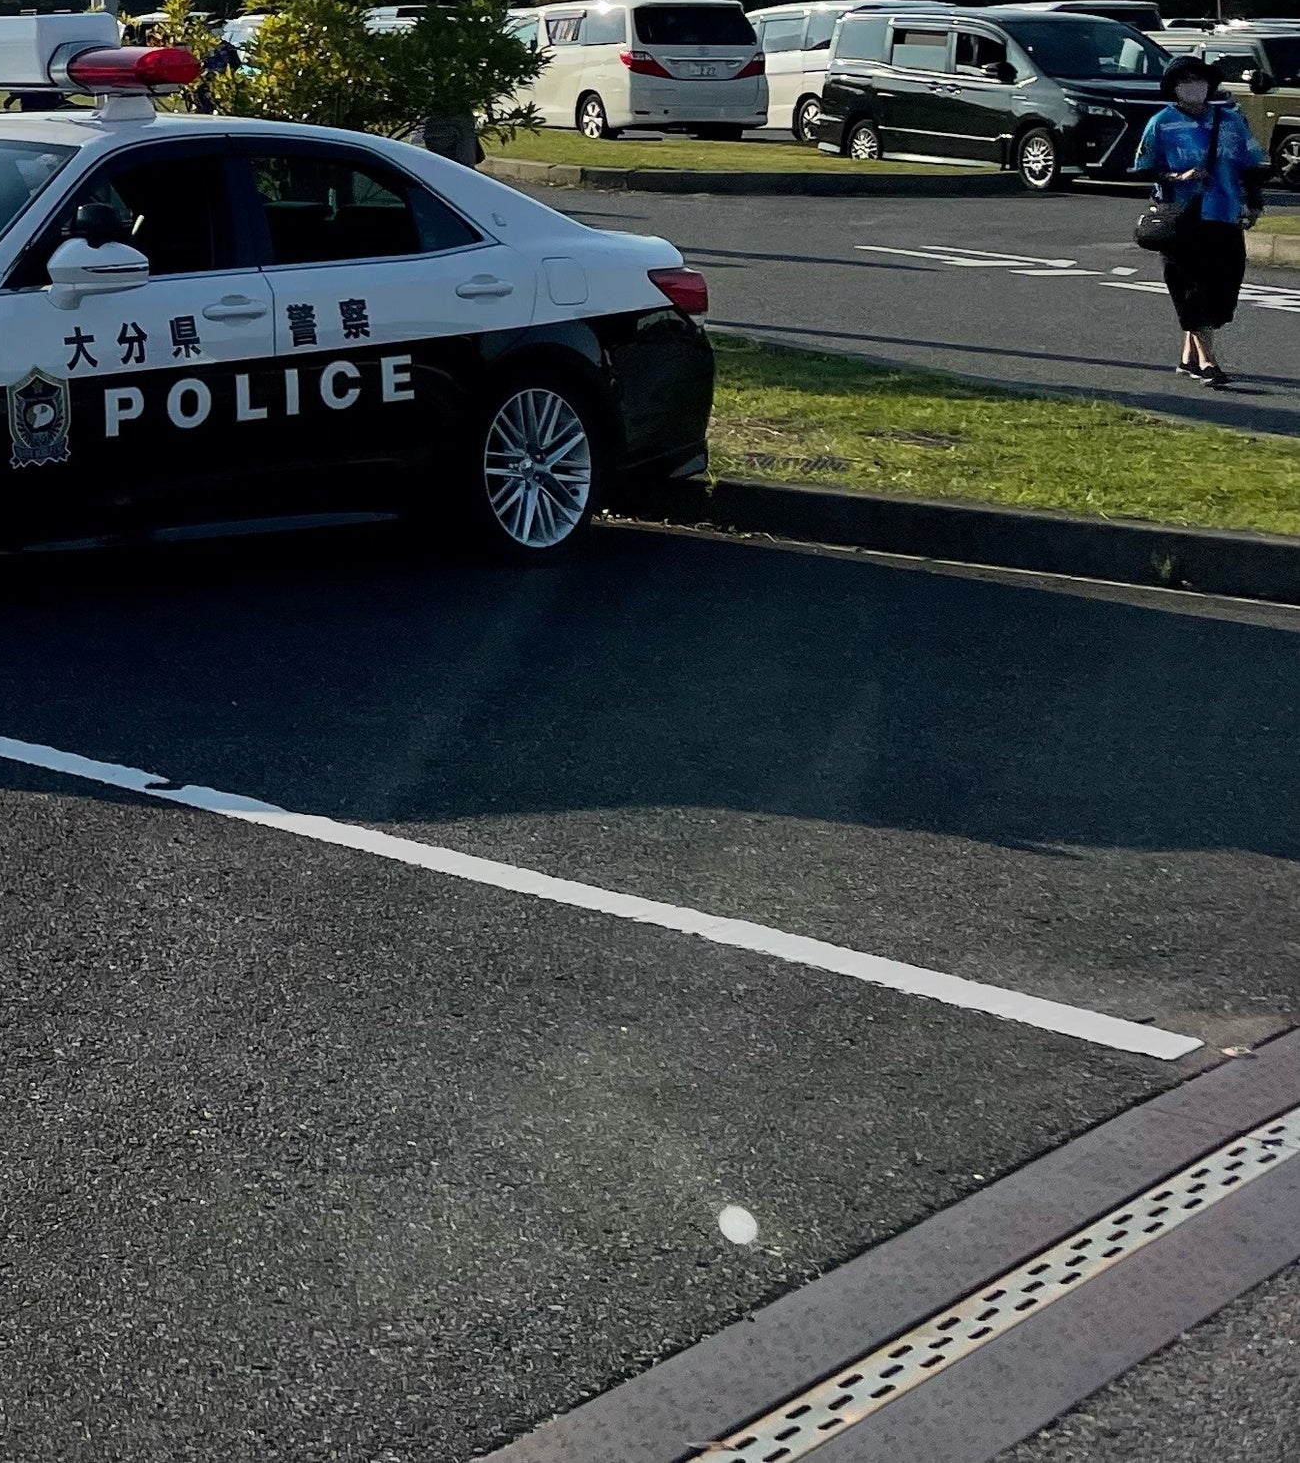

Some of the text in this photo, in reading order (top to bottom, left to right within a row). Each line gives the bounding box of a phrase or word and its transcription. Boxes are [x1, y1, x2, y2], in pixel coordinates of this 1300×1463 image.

[64, 298, 371, 371] 大分県 警察
[104, 354, 415, 438] POLICE
